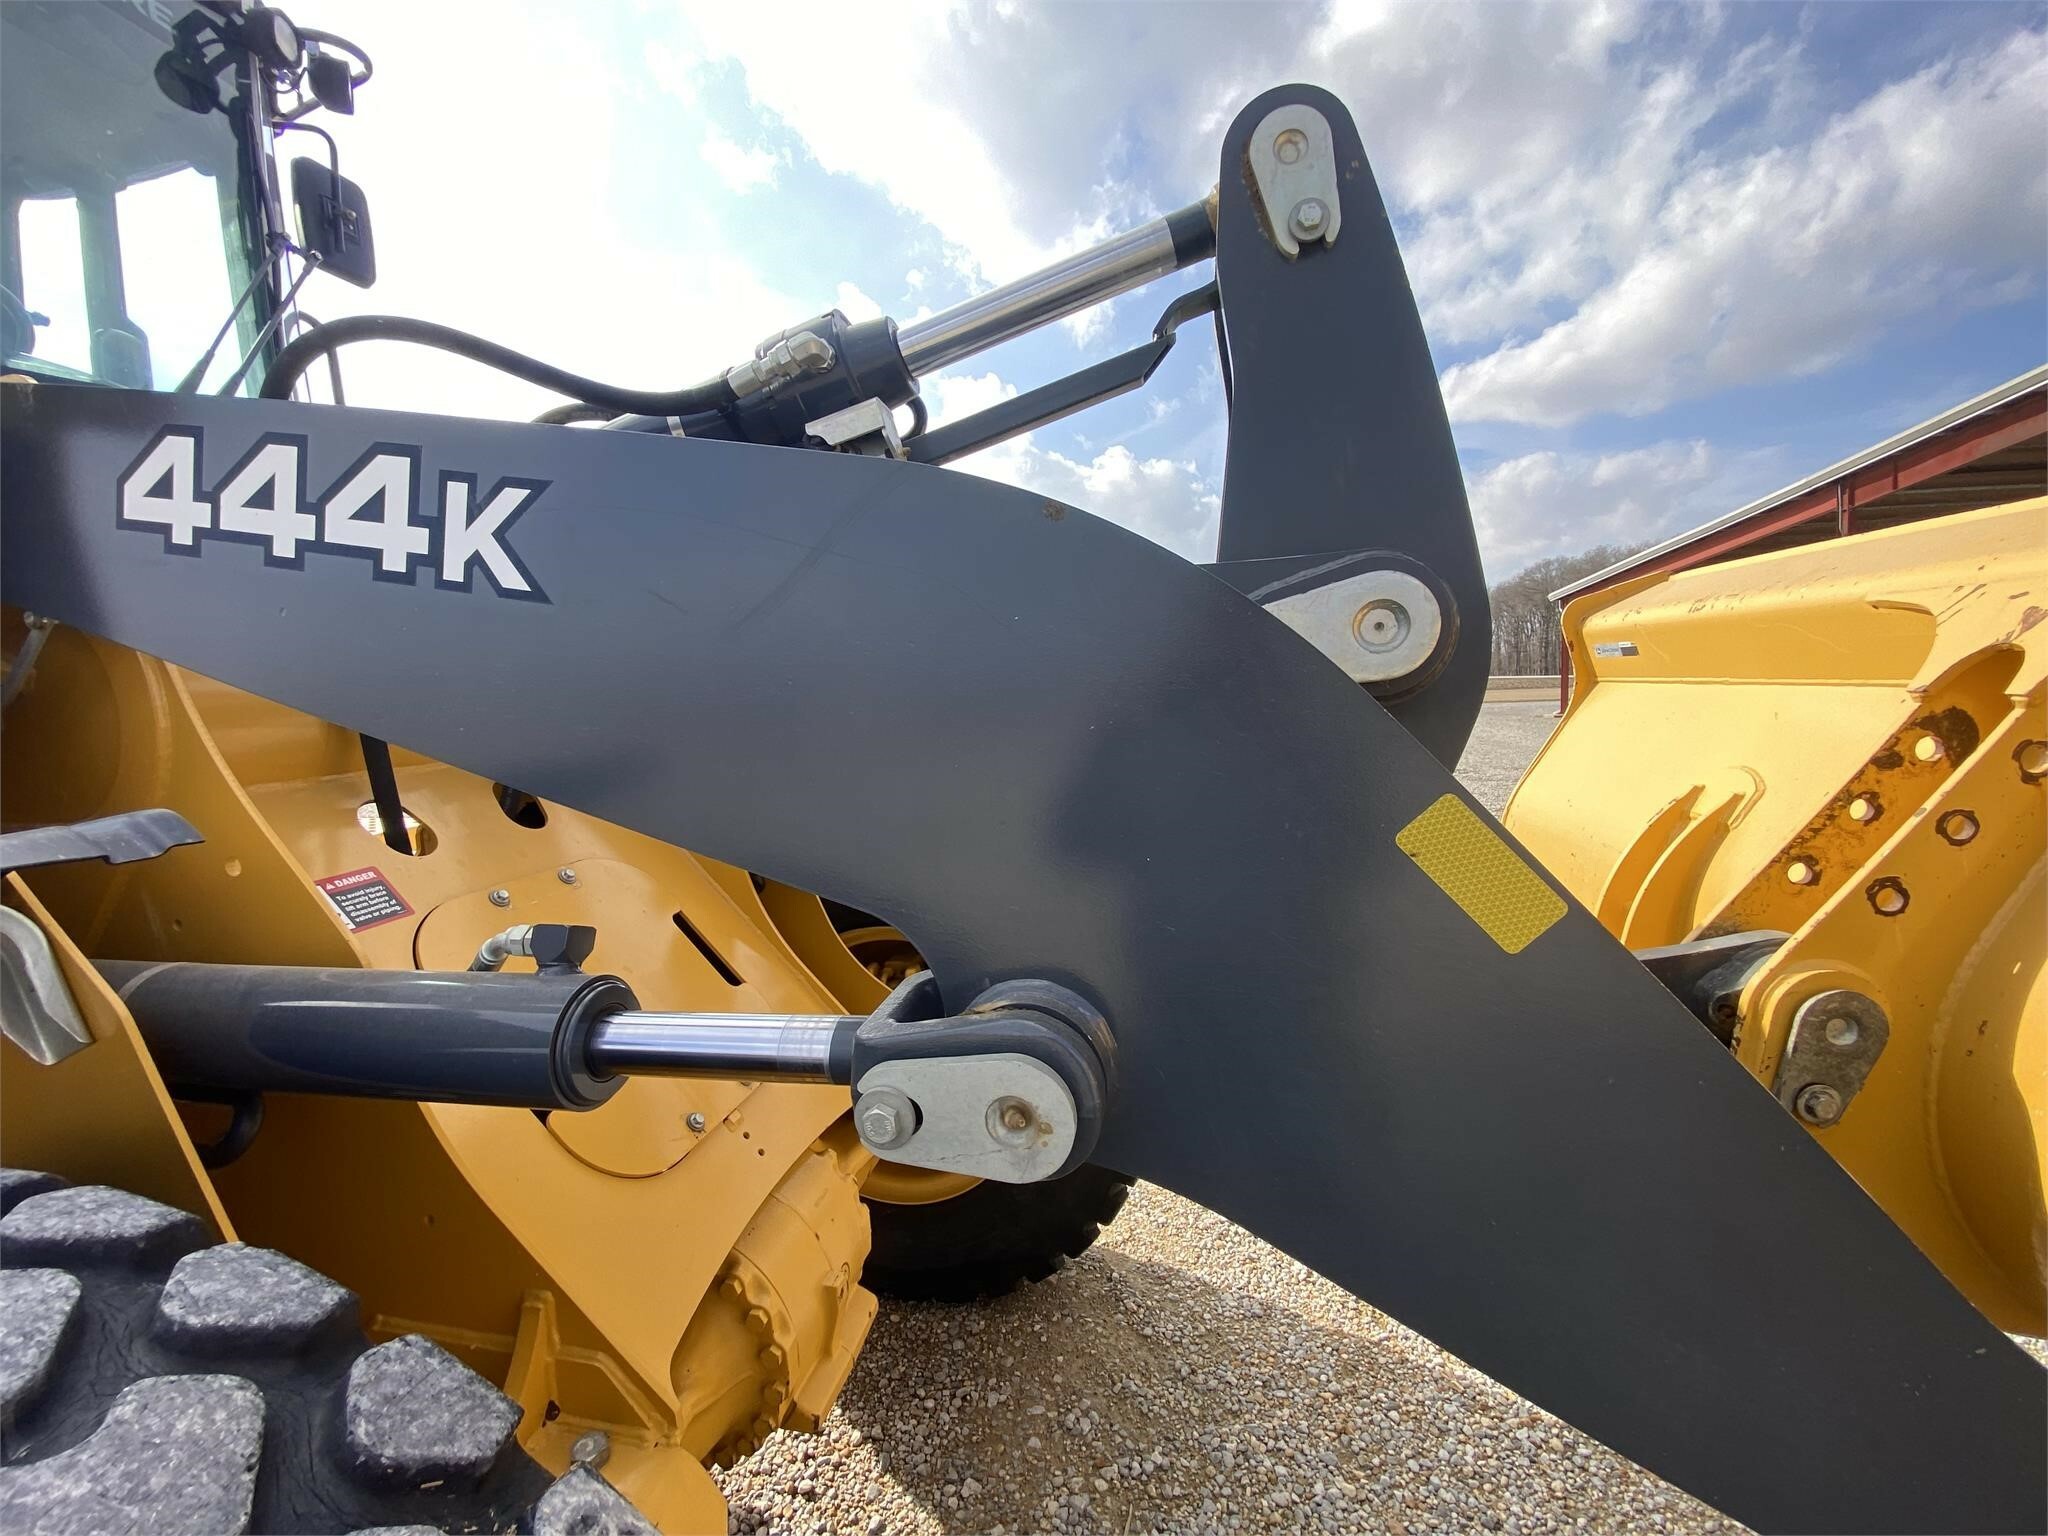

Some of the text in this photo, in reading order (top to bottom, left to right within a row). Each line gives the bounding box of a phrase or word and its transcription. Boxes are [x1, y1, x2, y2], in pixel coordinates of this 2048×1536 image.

[120, 432, 537, 595] 444K
[334, 871, 377, 887] DANGER
[346, 889, 365, 898] avoid
[368, 890, 387, 899] brace
[368, 896, 390, 905] before
